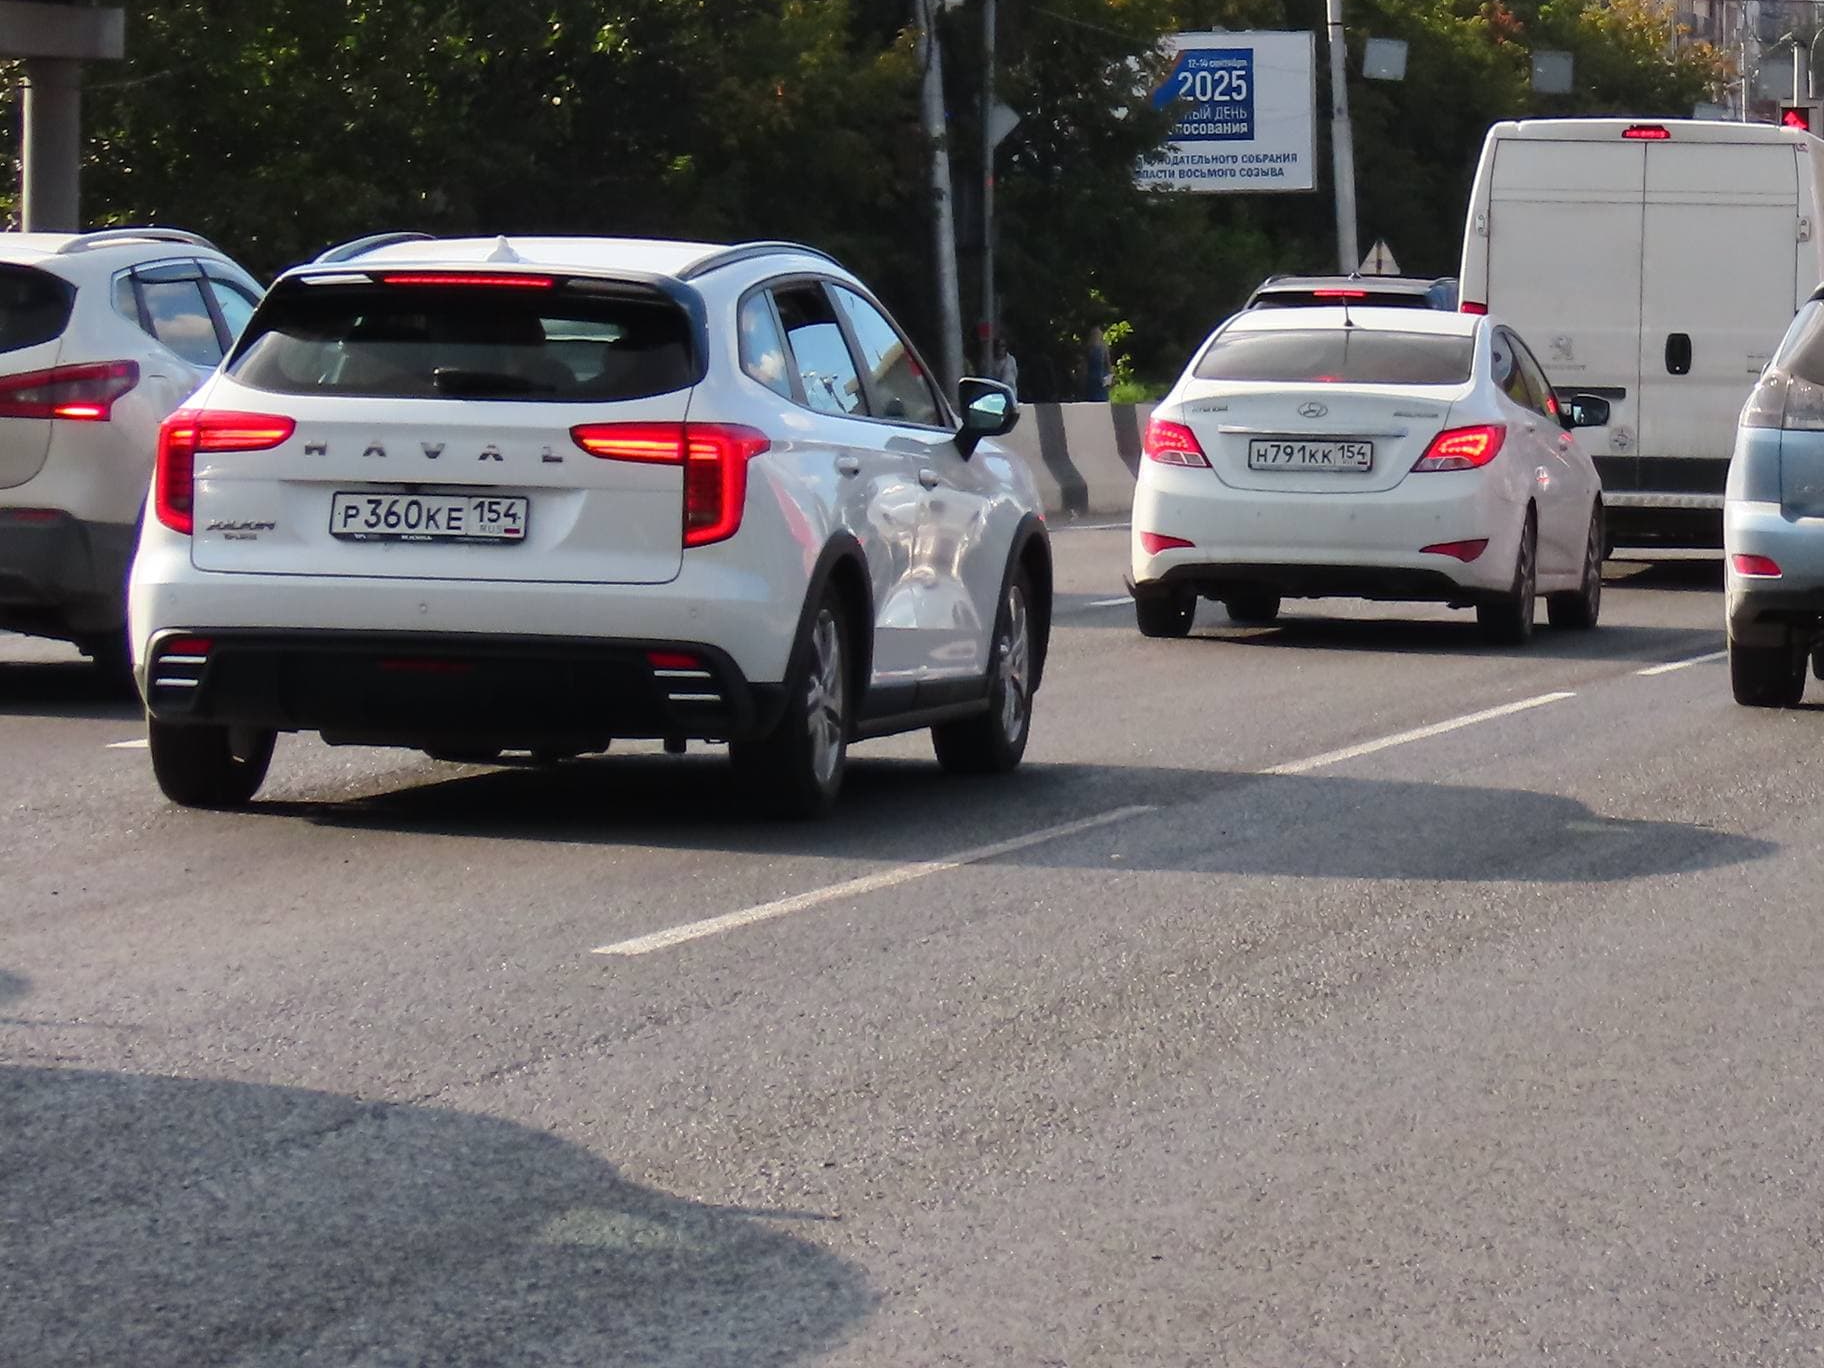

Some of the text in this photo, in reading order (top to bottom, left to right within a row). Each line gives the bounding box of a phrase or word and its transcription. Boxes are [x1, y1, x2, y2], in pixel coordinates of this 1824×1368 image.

[1178, 70, 1247, 102] 2025
[1214, 106, 1247, 121] ДЕНЬ
[1241, 153, 1298, 164] СОБРАНИЯ
[1179, 168, 1236, 179] ВОСЬМОГО
[1239, 167, 1285, 178] СОЗЫВА
[304, 440, 563, 463] HAVAL
[1256, 444, 1366, 464] Н791КК 154
[343, 499, 518, 530] Р360КЕ 154
